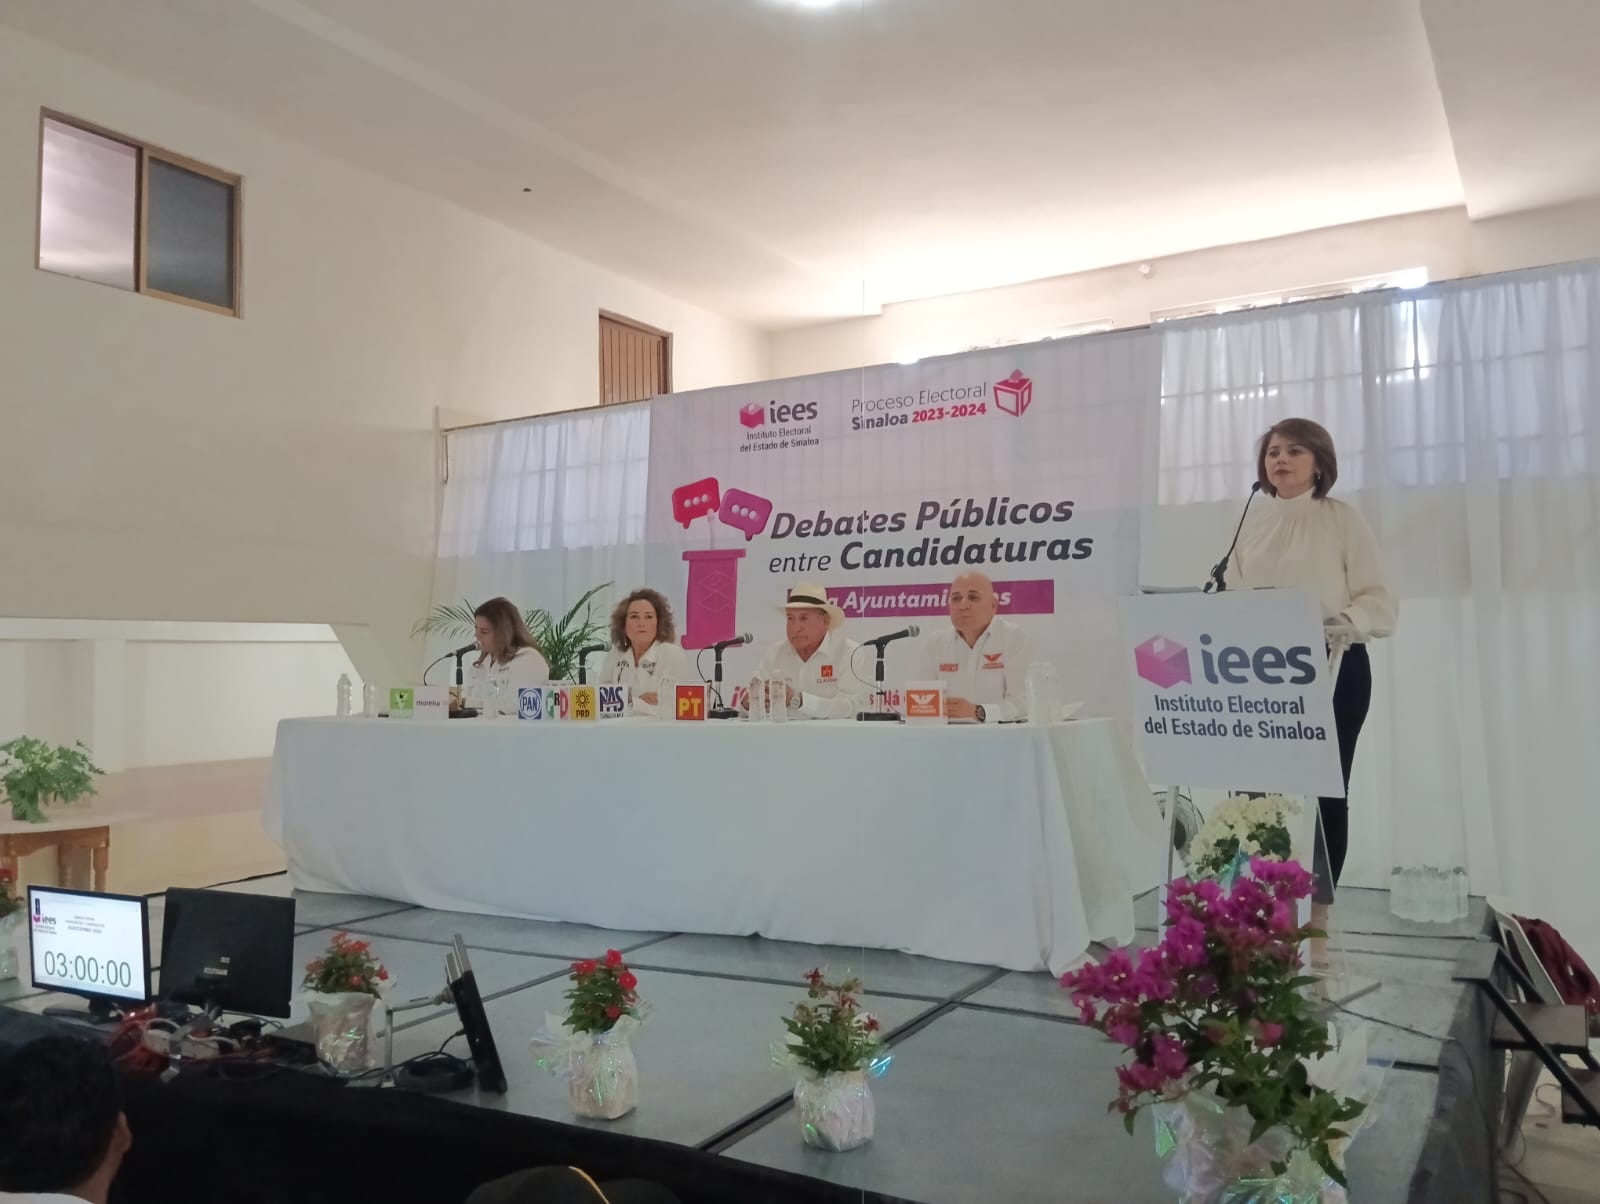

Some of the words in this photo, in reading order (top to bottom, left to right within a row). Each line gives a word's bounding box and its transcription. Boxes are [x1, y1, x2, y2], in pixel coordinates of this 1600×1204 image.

[852, 395, 914, 414] Proceso
[919, 381, 987, 405] Electoral
[769, 400, 818, 424] iees
[851, 413, 909, 430] Sinaloa
[912, 402, 987, 423] 2023-2024
[740, 443, 752, 452] del
[753, 441, 778, 451] Estado
[780, 439, 789, 449] de
[791, 437, 819, 448] Sinaloa
[746, 430, 777, 441] Instituto
[779, 425, 812, 437] Electoral
[770, 510, 907, 539] Debates
[915, 497, 1075, 531] Públicos
[769, 552, 831, 573] entre
[840, 535, 1094, 570] Candidaturas
[1199, 633, 1317, 685] iees
[522, 696, 539, 712] PAN
[576, 709, 590, 718] PRD
[678, 697, 701, 718] PT
[1154, 694, 1223, 713] Instituto
[1228, 694, 1305, 715] Electoral
[1144, 716, 1168, 735] del
[1171, 718, 1228, 738] Estado
[1232, 719, 1254, 738] de
[1258, 720, 1327, 741] Sinaloa
[44, 950, 132, 988] 03:00:00
